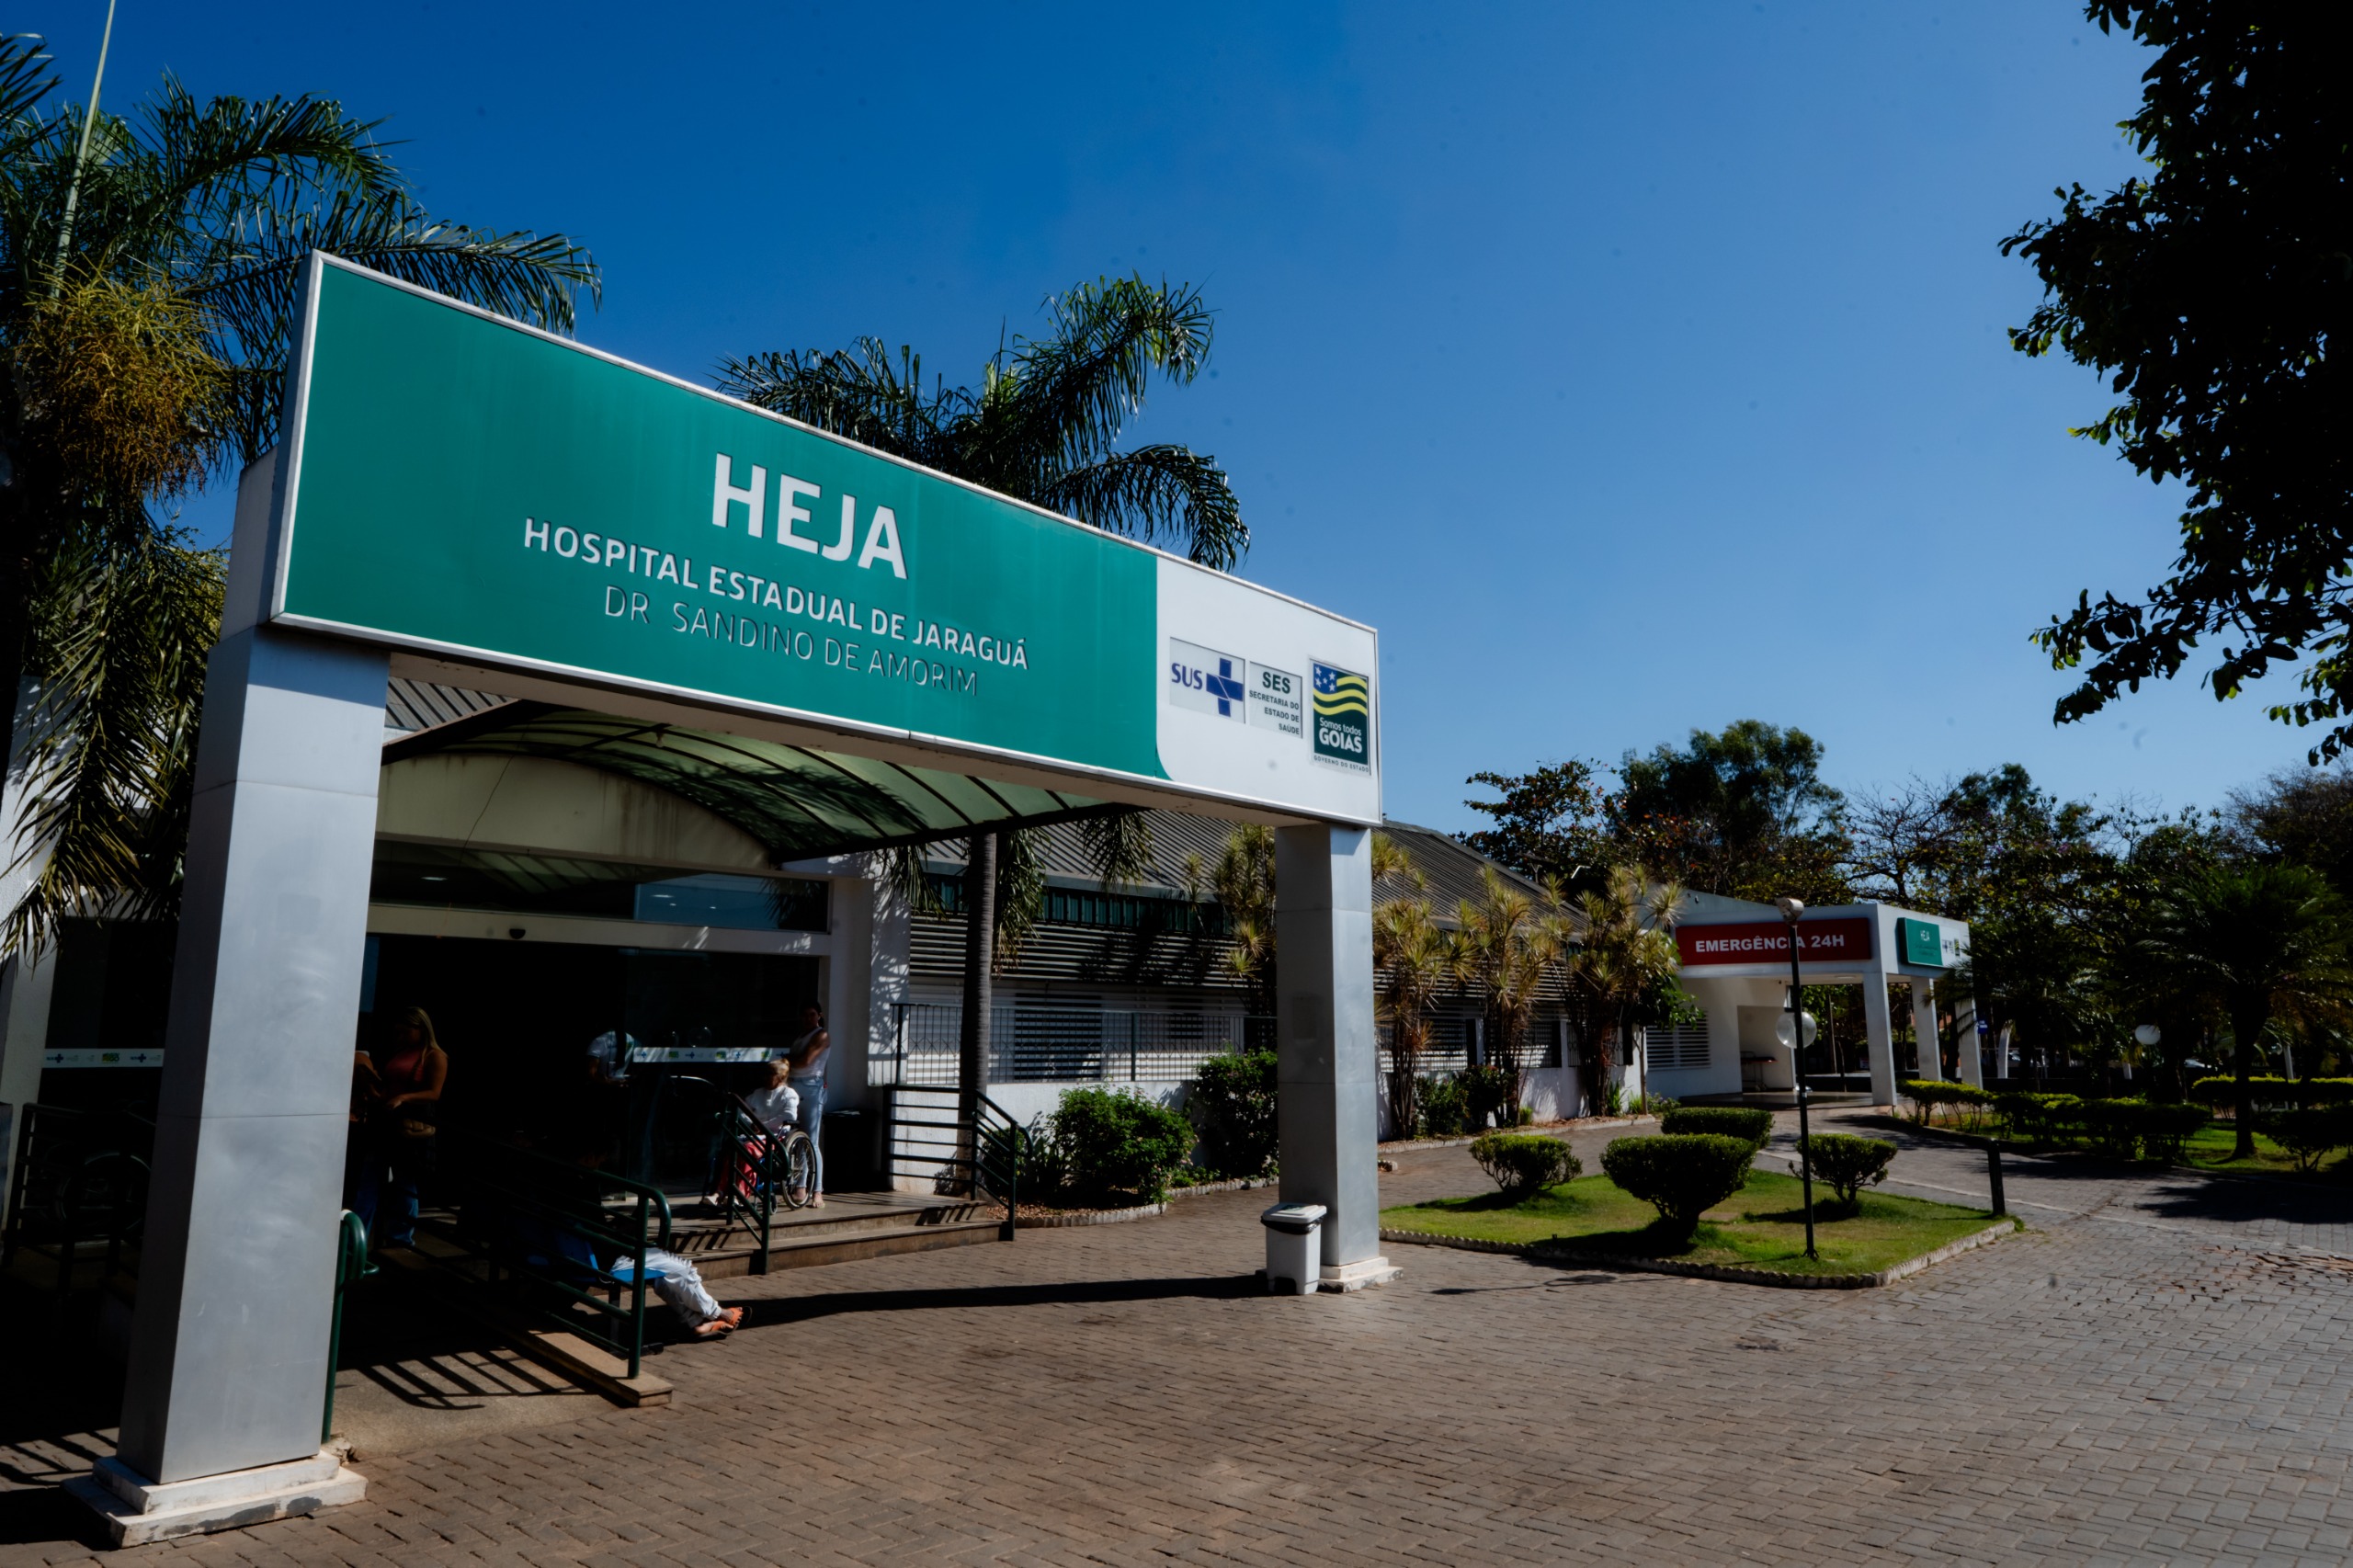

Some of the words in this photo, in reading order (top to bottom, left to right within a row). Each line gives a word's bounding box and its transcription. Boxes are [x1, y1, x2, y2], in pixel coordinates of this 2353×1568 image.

[712, 452, 908, 580] HEJA
[524, 517, 699, 589] HOSPITAL
[710, 564, 862, 631] ESTADUAL
[870, 608, 906, 641] DE
[913, 619, 1029, 670] JARAGUÁ
[605, 585, 651, 625] DR
[673, 602, 814, 661] SANDINO
[824, 638, 861, 671] DE
[868, 649, 977, 697] AMORIM
[1171, 662, 1203, 690] SUS
[1262, 671, 1291, 695] SES
[1249, 689, 1289, 708] SECRETARIA
[1290, 702, 1300, 710] DO
[1264, 707, 1290, 721] ESTADO
[1290, 715, 1300, 723] DE
[1279, 722, 1300, 735] SAÚDE
[1319, 717, 1342, 732] Somos
[1343, 724, 1362, 736] todos
[1313, 755, 1339, 767] GOVERNO
[1349, 763, 1370, 773] ESTADO
[1695, 935, 1806, 953] EMERGÊNCIA
[1811, 934, 1845, 949] 24H
